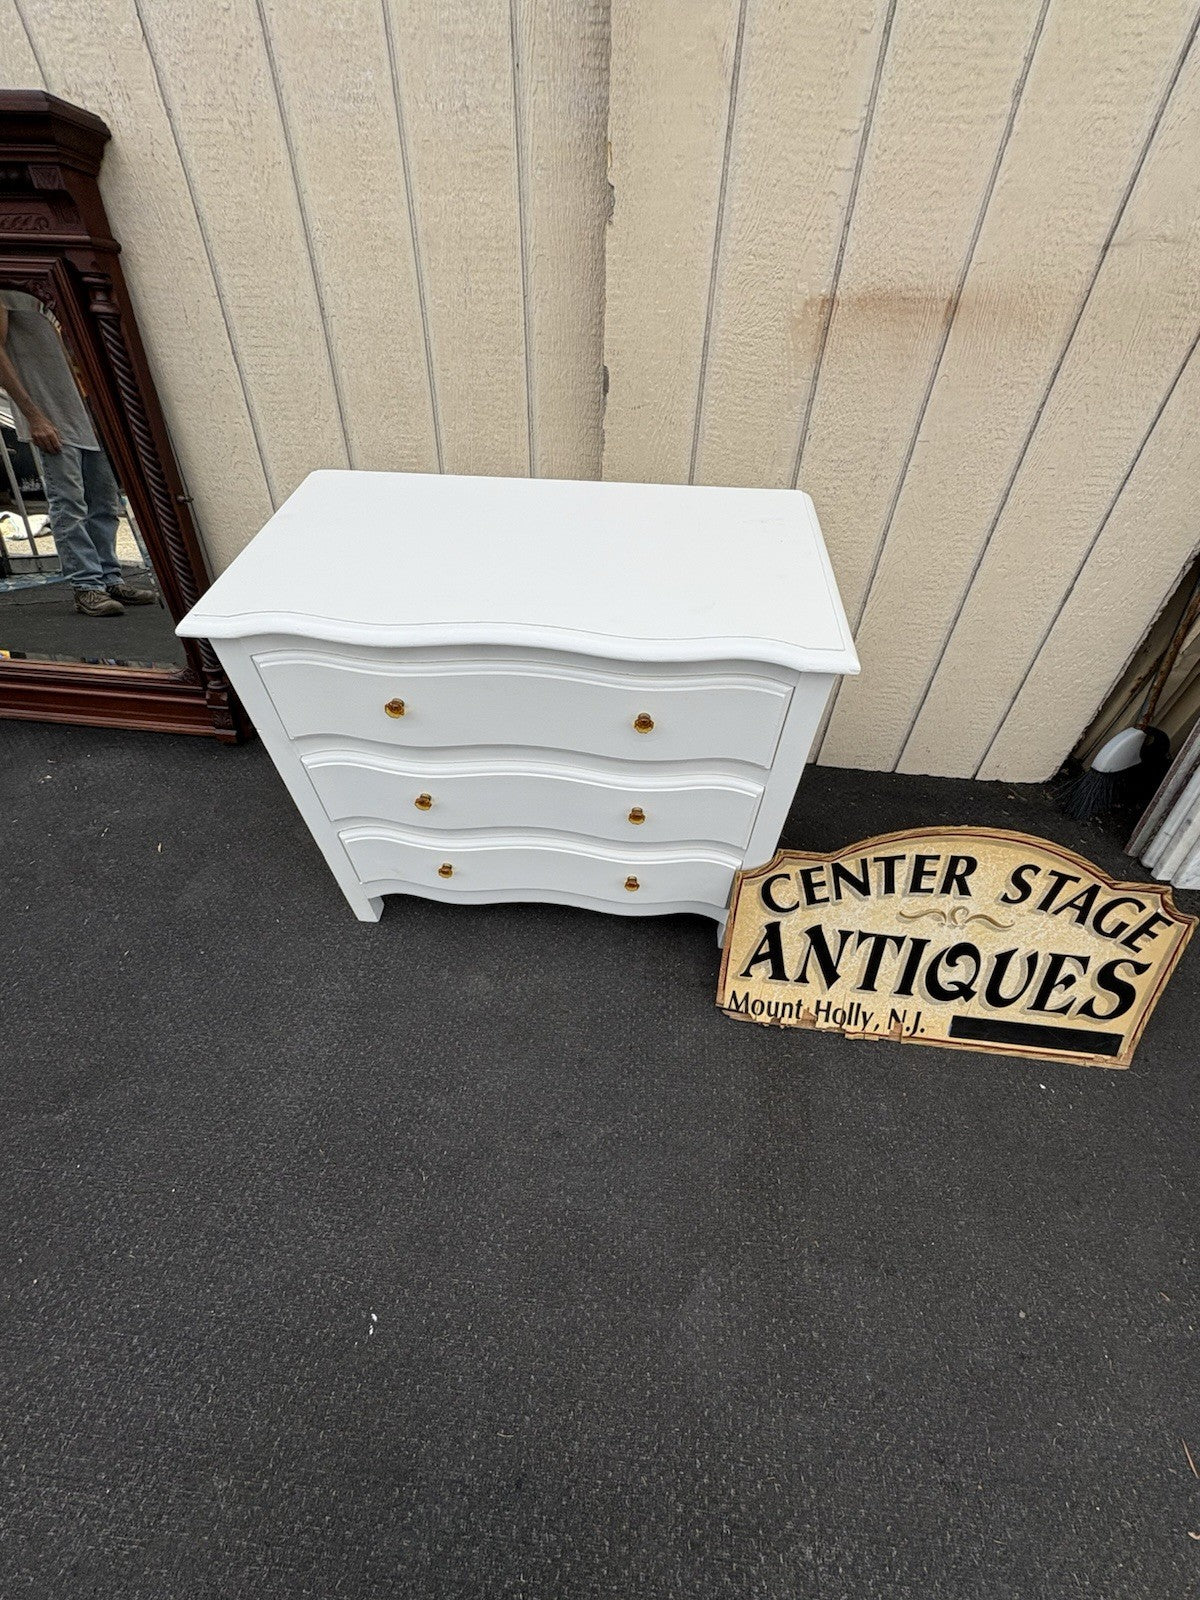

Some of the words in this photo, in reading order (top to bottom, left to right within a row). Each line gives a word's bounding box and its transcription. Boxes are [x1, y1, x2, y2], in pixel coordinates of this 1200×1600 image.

[761, 854, 978, 913] CENTER
[1000, 864, 1174, 954] STAGE
[728, 990, 804, 1020] Mount
[815, 1000, 880, 1032] Holly,
[887, 1008, 926, 1036] N.J.
[739, 921, 1153, 1020] ANTIQUES
